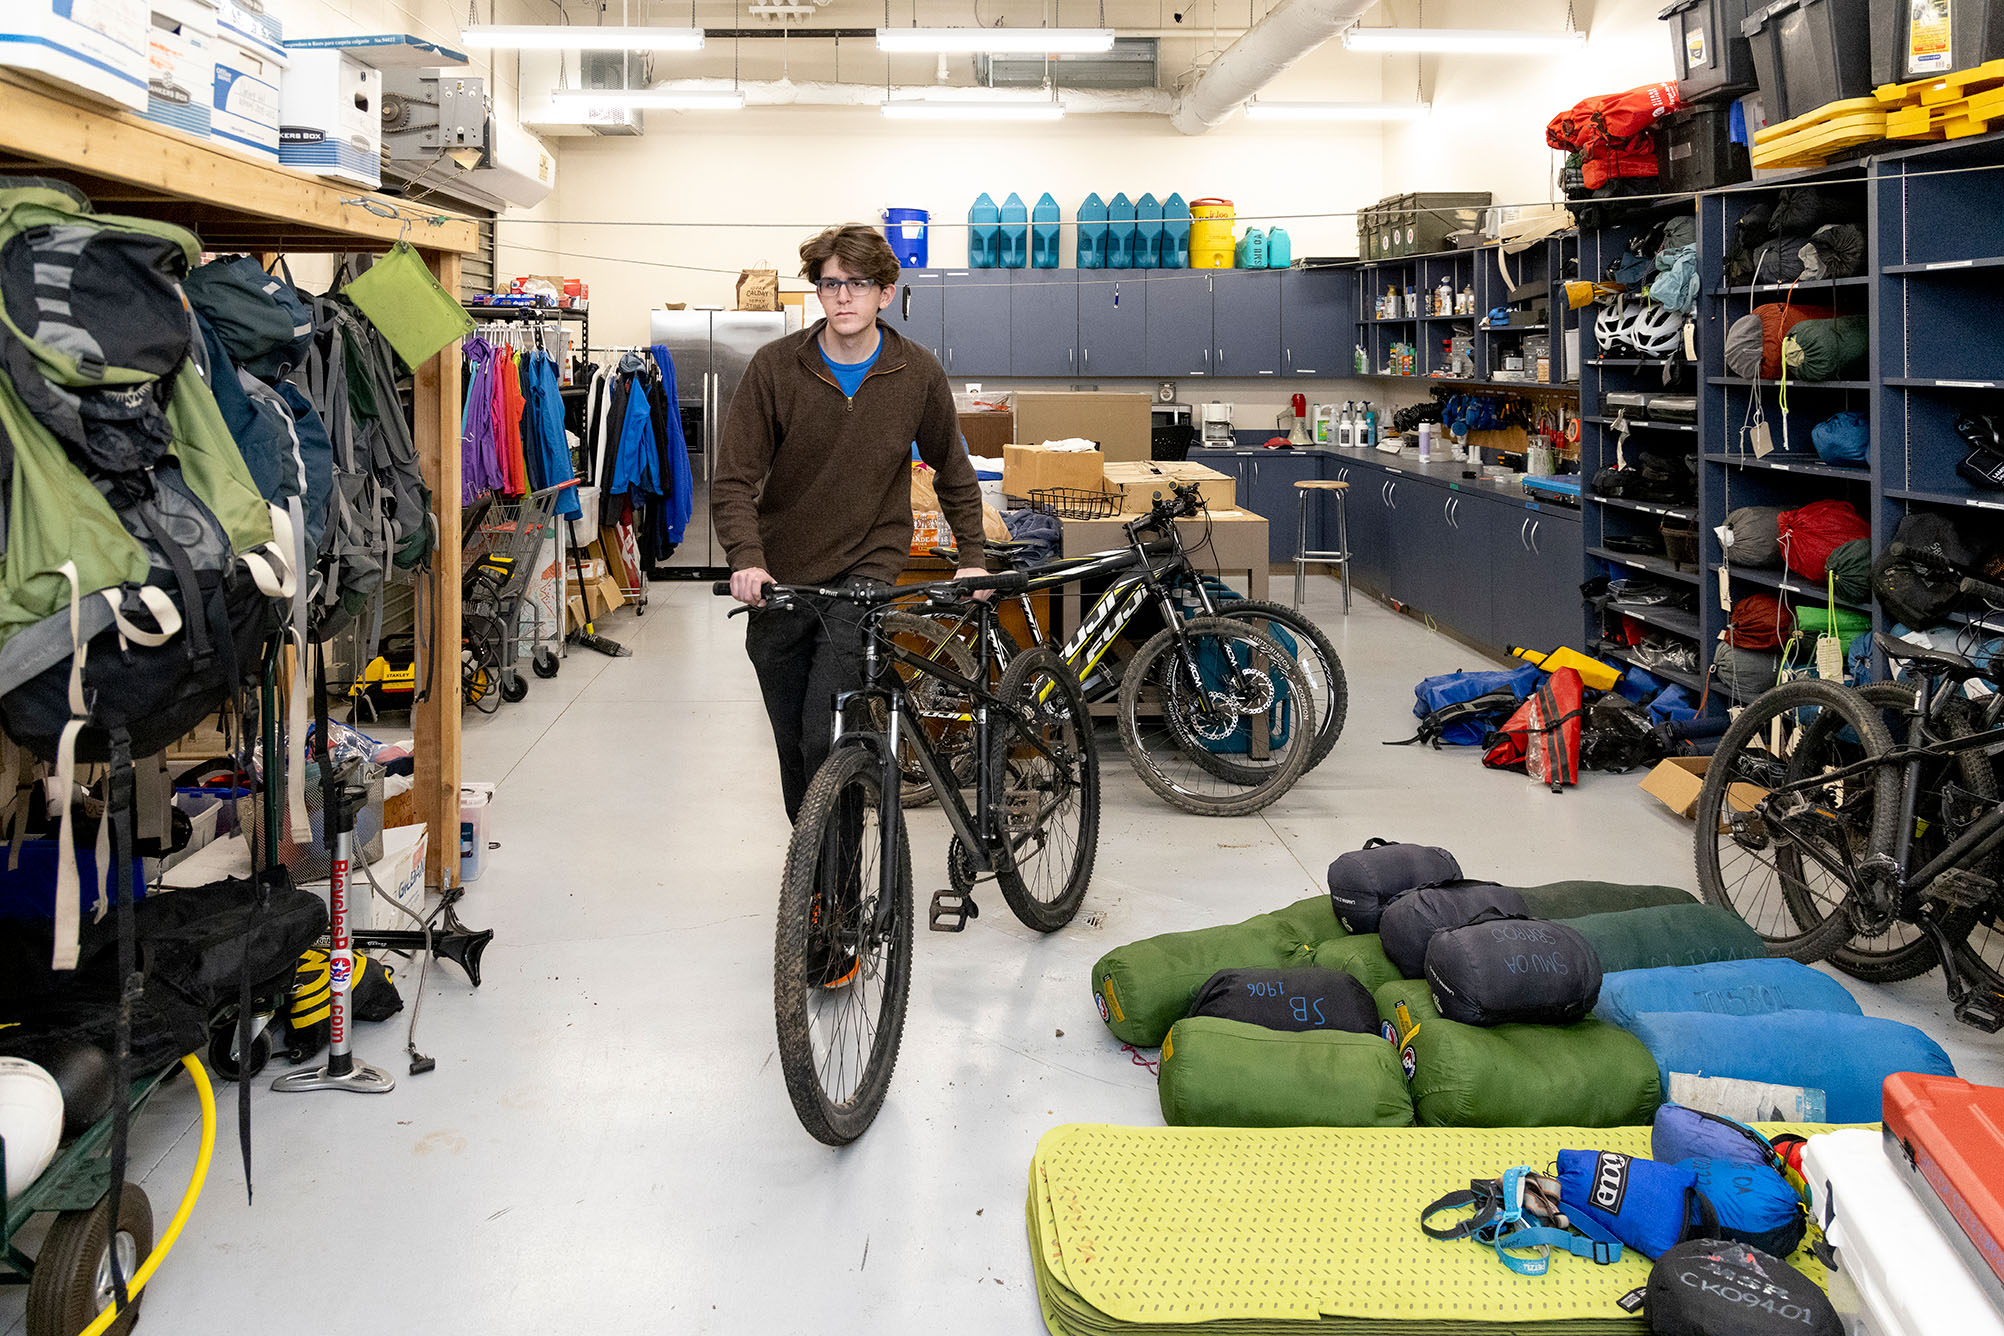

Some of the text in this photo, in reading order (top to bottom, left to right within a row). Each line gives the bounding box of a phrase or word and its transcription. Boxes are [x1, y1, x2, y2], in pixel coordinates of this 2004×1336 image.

[149, 85, 173, 98] ANKERS
[1209, 210, 1228, 218] igloo
[1254, 234, 1262, 265] SMU OA
[1086, 584, 1148, 664] FUJI
[1253, 635, 1291, 671] HUTCHINSON
[398, 858, 425, 900] GILBAN
[1503, 951, 1569, 976] SMU OA
[1247, 981, 1285, 997] 1906
[1289, 996, 1326, 1025] SB
